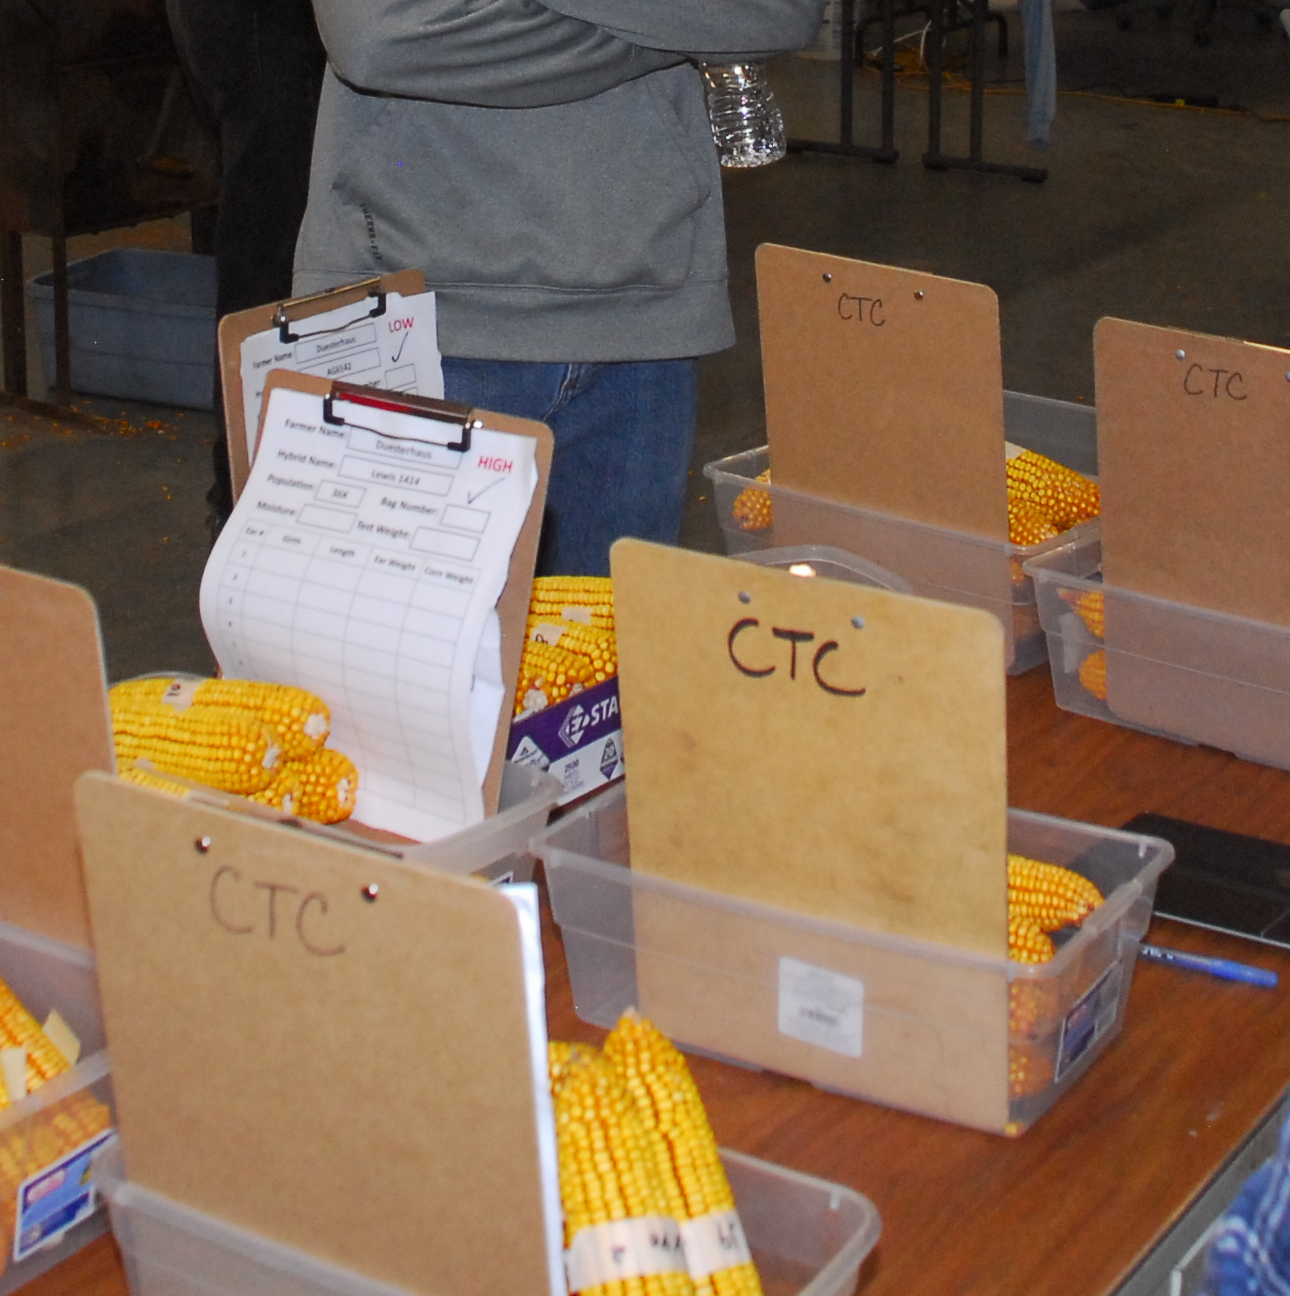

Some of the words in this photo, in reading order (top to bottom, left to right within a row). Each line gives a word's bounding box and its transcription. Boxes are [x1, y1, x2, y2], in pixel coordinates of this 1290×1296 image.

[837, 292, 886, 328] CTC
[388, 317, 414, 333] LOW
[1183, 363, 1249, 401] CTC
[284, 418, 316, 434] Farmer
[277, 449, 307, 467] Hybrid
[375, 440, 432, 459] Duesterhaus
[477, 456, 513, 473] HIGH
[371, 469, 396, 483] Lewis
[398, 474, 420, 486] 1414
[380, 496, 399, 510] Bag
[357, 520, 375, 533] Test
[388, 557, 416, 572] Weight
[424, 566, 443, 577] Corn
[445, 571, 474, 585] Weight
[727, 618, 866, 697] CTC
[209, 865, 346, 957] CTC
